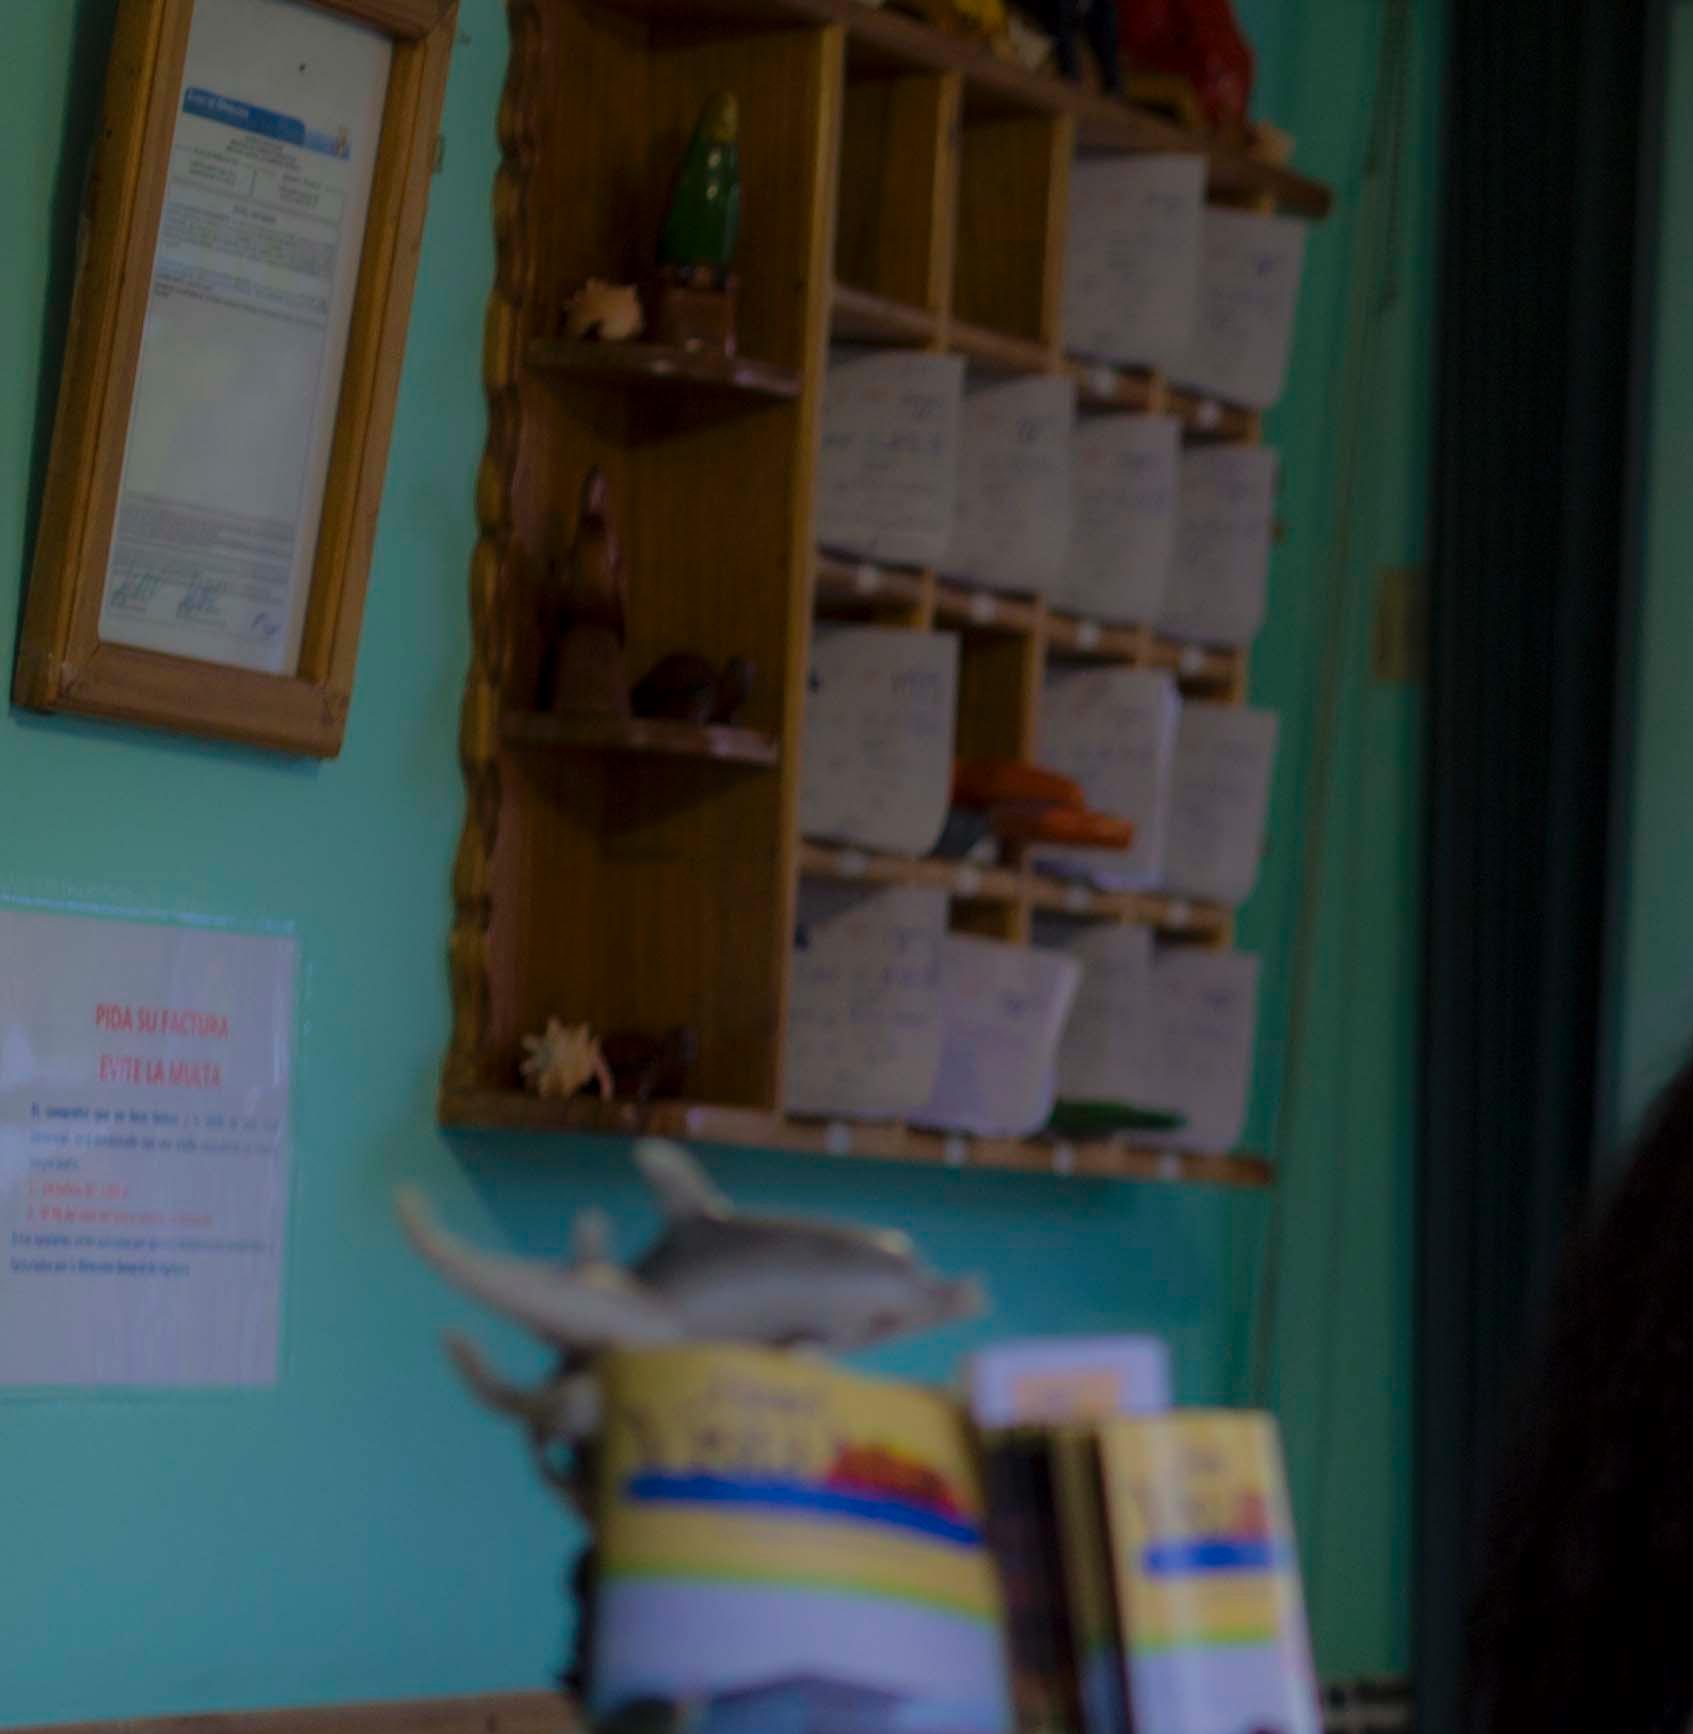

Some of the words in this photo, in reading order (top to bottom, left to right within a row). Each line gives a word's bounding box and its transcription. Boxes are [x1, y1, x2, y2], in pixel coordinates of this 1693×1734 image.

[96, 1002, 132, 1032] PIDA
[137, 1006, 158, 1035] SU
[161, 1009, 229, 1039] FACTURA
[99, 1052, 141, 1085] EVITE
[146, 1057, 163, 1086] LA
[168, 1059, 221, 1088] MULTA
